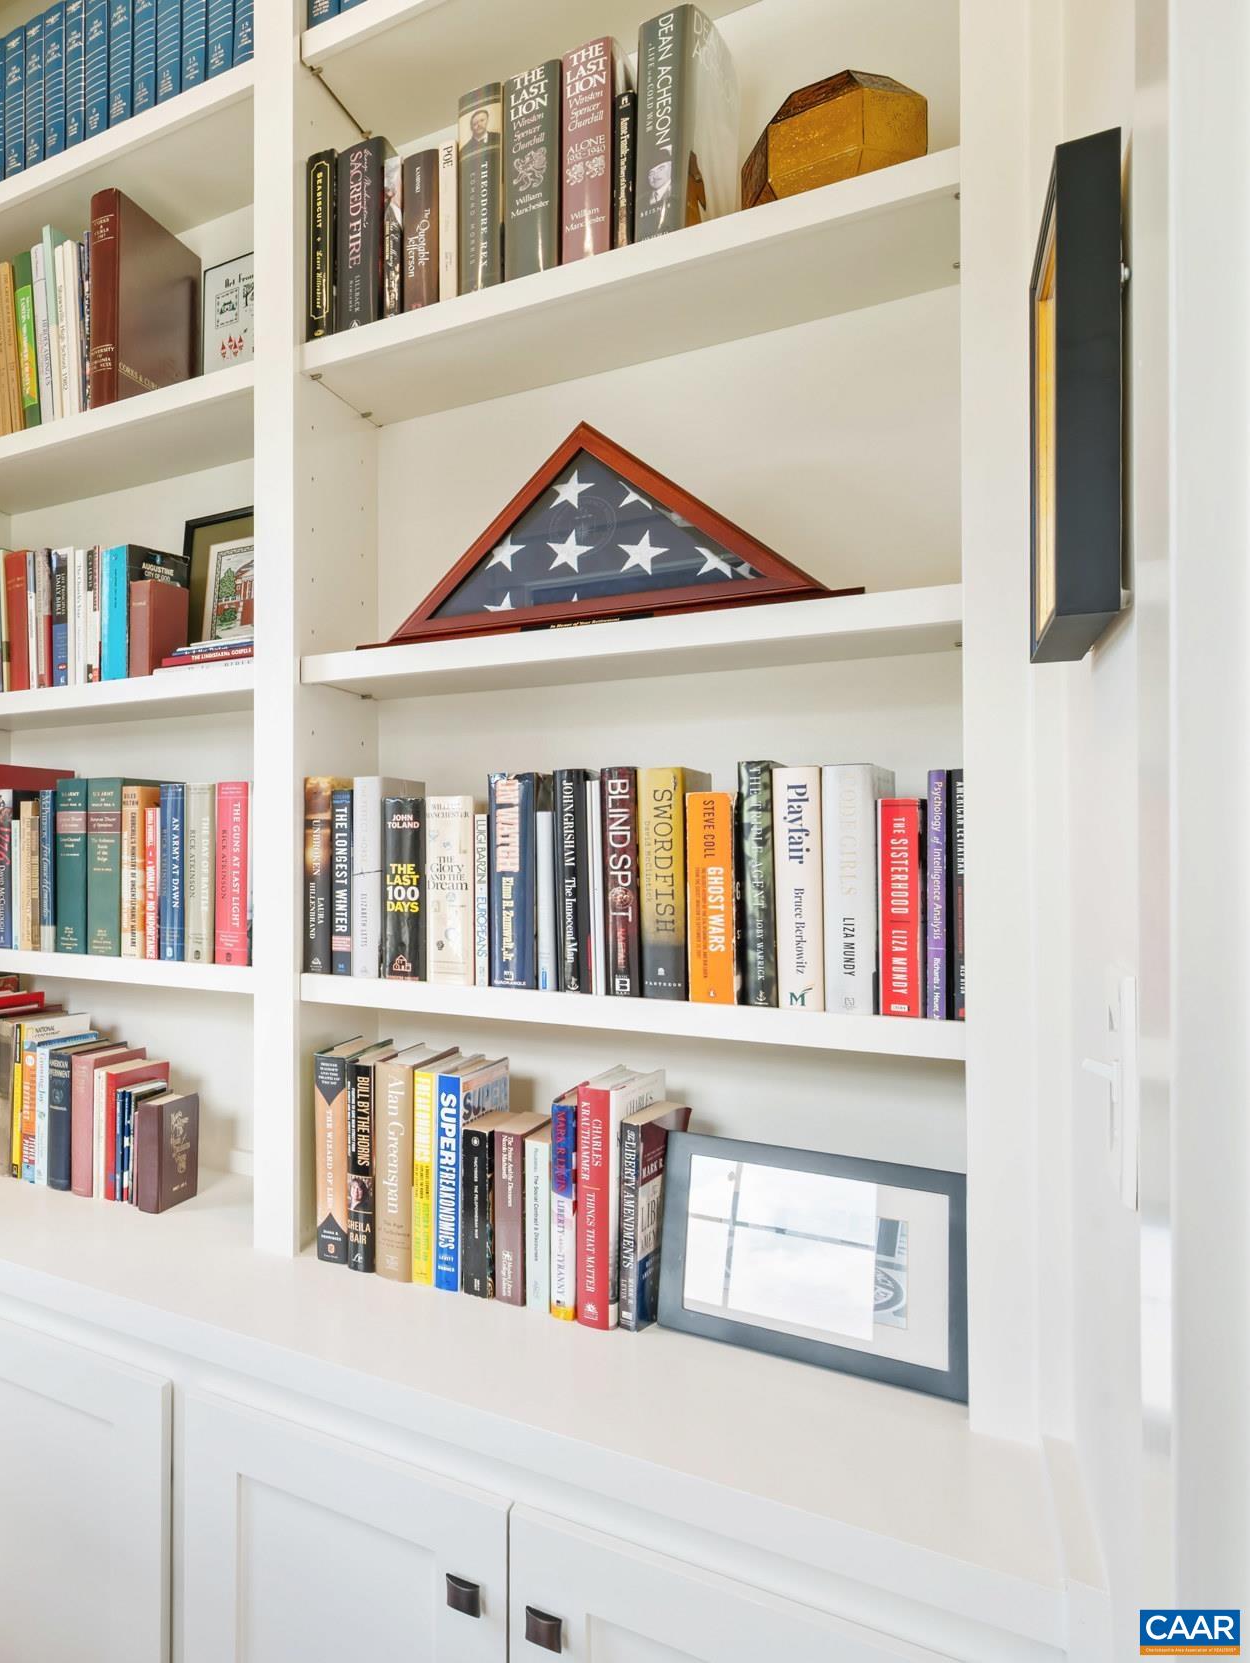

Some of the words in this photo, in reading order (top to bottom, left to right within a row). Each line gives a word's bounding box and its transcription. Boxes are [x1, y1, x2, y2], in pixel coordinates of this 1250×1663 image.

[658, 13, 674, 62] DEAN
[569, 42, 604, 68] THE
[513, 66, 545, 90] THE
[566, 57, 607, 85] LAST
[510, 79, 548, 107] LAST
[566, 72, 607, 99] LION
[568, 90, 604, 108] Winston
[510, 94, 548, 122] LION
[570, 101, 601, 121] Spencer
[655, 65, 673, 146] ACHESON
[512, 113, 544, 131] Winston
[513, 124, 542, 144] Spencer
[568, 110, 604, 132] Churchill
[512, 132, 545, 153] Churchill
[567, 134, 606, 154] ALONE
[349, 151, 363, 217] SACRED
[480, 161, 489, 234] THEODORE
[511, 200, 549, 219] Manchester
[515, 191, 543, 206] William
[570, 206, 600, 221] William
[349, 219, 362, 269] FIRE
[406, 235, 419, 278] Jefferson
[415, 219, 431, 267] Quotable
[480, 241, 488, 267] REX
[225, 278, 236, 289] Art
[141, 562, 175, 577] AUGUSTINE
[144, 570, 154, 578] CITY
[749, 767, 762, 796] THE
[562, 780, 574, 812] JOHN
[931, 781, 943, 832] Psychology
[171, 817, 179, 830] AN
[232, 802, 241, 823] THE
[335, 807, 348, 830] THE
[392, 814, 413, 822] JOHN
[608, 779, 631, 848] BLIND
[703, 800, 715, 830] STEVE
[750, 800, 764, 853] TRIPLE
[783, 784, 811, 865] Playfair
[893, 817, 906, 835] THE
[232, 825, 241, 853] GUNS
[476, 819, 487, 844] LUIGI
[563, 813, 576, 867] GRISHAM
[931, 836, 943, 845] of
[171, 833, 179, 862] ARMY
[312, 820, 320, 876] UNBROKEN
[335, 833, 348, 885] LONGEST
[703, 834, 715, 859] COLL
[171, 863, 179, 875] AT
[232, 855, 241, 867] AT
[389, 864, 416, 875] THE
[430, 862, 465, 876] Glory
[476, 847, 488, 884] BARZINI
[653, 789, 675, 933] SWORDFISH
[931, 848, 943, 900] Intelligence
[146, 866, 155, 891] WOMAN
[232, 870, 241, 894] LAST
[386, 875, 419, 886] LAST
[426, 881, 469, 891] Dream
[565, 877, 577, 897] The
[707, 867, 725, 911] GHOST
[750, 858, 767, 909] AGENT
[890, 838, 909, 915] SISTERHOOD
[146, 901, 155, 911] NO
[171, 878, 180, 909] DAWN
[386, 886, 420, 901] 100
[386, 901, 420, 913] DAYS
[793, 888, 805, 918] Bruce
[232, 896, 241, 928] LIGHT
[317, 897, 325, 925] LAURA
[335, 889, 348, 933] WINTER
[565, 898, 578, 941] Innocent
[931, 903, 943, 940] Analysis
[476, 896, 488, 958] EUROPEANS
[708, 913, 726, 952] WARS
[756, 919, 764, 939] JOBY
[842, 917, 855, 939] LIZA
[891, 930, 908, 952] LIZA
[566, 942, 578, 963] Man
[757, 940, 765, 981] WARRICK
[794, 920, 808, 975] Berkowitz
[843, 941, 856, 977] MUNDY
[891, 956, 908, 995] MUNDY
[357, 1076, 370, 1099] BULL
[388, 1075, 405, 1117] Alan
[325, 1110, 333, 1128] THE
[357, 1101, 370, 1115] BY
[357, 1116, 370, 1133] THE
[556, 1111, 567, 1144] MARK
[326, 1131, 334, 1170] WIZARD
[357, 1135, 370, 1167] HORNS
[580, 1101, 591, 1181] KRAUTHAMMER
[591, 1119, 603, 1168] CHARLES
[383, 1122, 405, 1214] Greenspan
[623, 1140, 637, 1187] LIBERTY
[326, 1172, 334, 1185] OF
[556, 1200, 565, 1240] LIBERTY
[585, 1192, 595, 1226] THINGS
[347, 1219, 371, 1233] SHEILA
[349, 1232, 367, 1245] BAIR
[622, 1188, 637, 1270] AMENDMENTS
[585, 1229, 595, 1254] THAT
[556, 1251, 565, 1297] TYRANNY
[585, 1256, 595, 1293] MATTER
